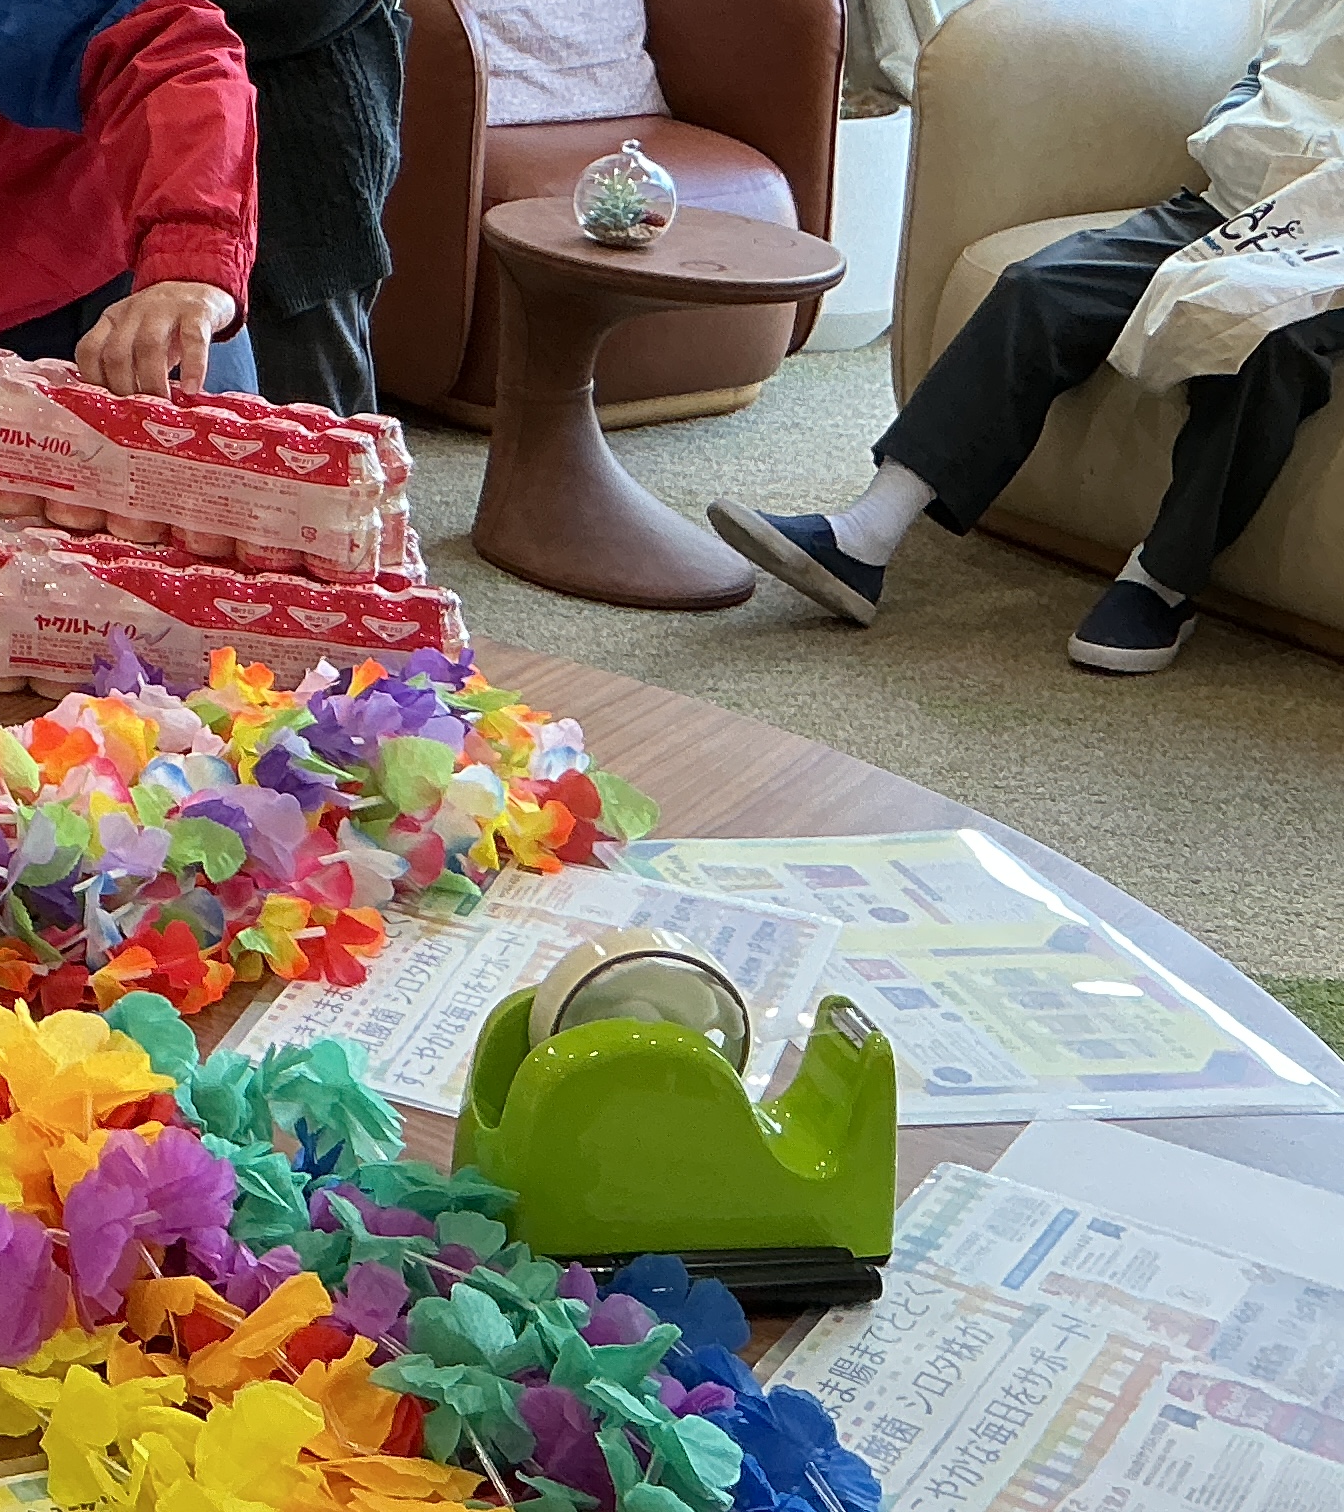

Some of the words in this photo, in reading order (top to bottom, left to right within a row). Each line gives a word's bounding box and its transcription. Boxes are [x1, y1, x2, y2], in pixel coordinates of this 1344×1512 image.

[902, 1317, 997, 1416] シロタ株が
